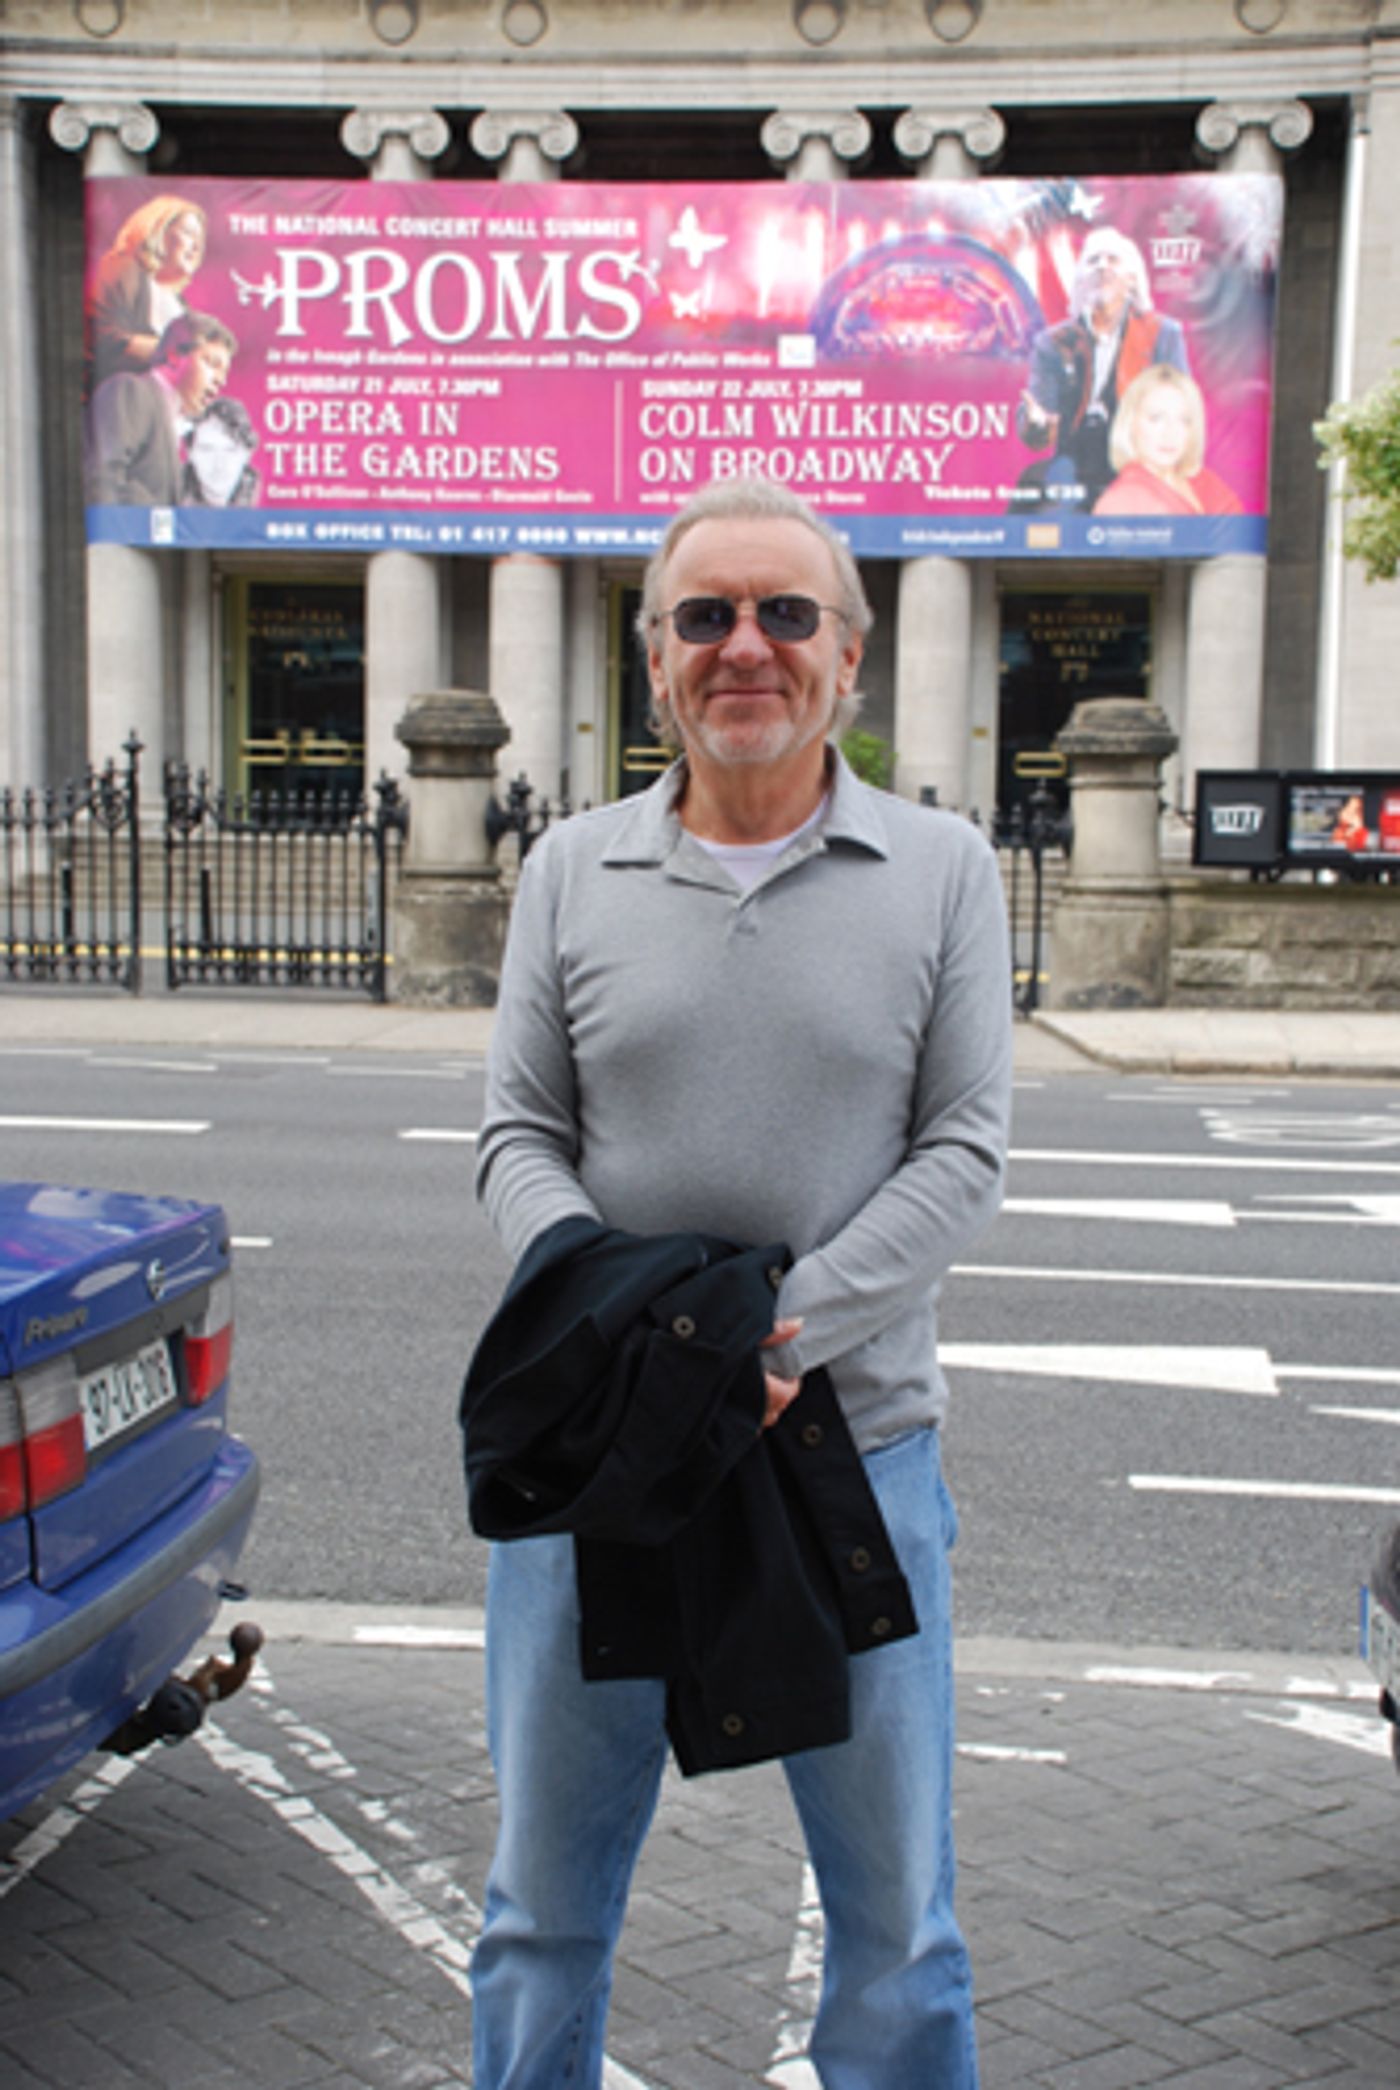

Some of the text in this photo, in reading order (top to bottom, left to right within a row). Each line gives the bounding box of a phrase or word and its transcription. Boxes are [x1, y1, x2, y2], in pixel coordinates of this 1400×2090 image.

[229, 213, 637, 238] THE NATIONAL CONCERT HALL SUMMER
[275, 248, 643, 346] PROMS
[671, 352, 720, 368] Public
[267, 374, 360, 394] SATURDAY
[642, 379, 717, 398] SUNDAY
[721, 379, 741, 398] 22
[264, 399, 460, 437] OPERA IN
[638, 400, 1010, 440] COLM WILKINSON
[264, 442, 560, 481] THE GARDENS
[639, 444, 955, 483] ON BROADWAY
[923, 486, 990, 501] Tickets
[996, 485, 1041, 500] from
[267, 522, 308, 541] BOX
[313, 523, 385, 541] OFFICE
[391, 524, 433, 542] TEL:
[438, 525, 463, 543] 01
[471, 526, 511, 544] 417
